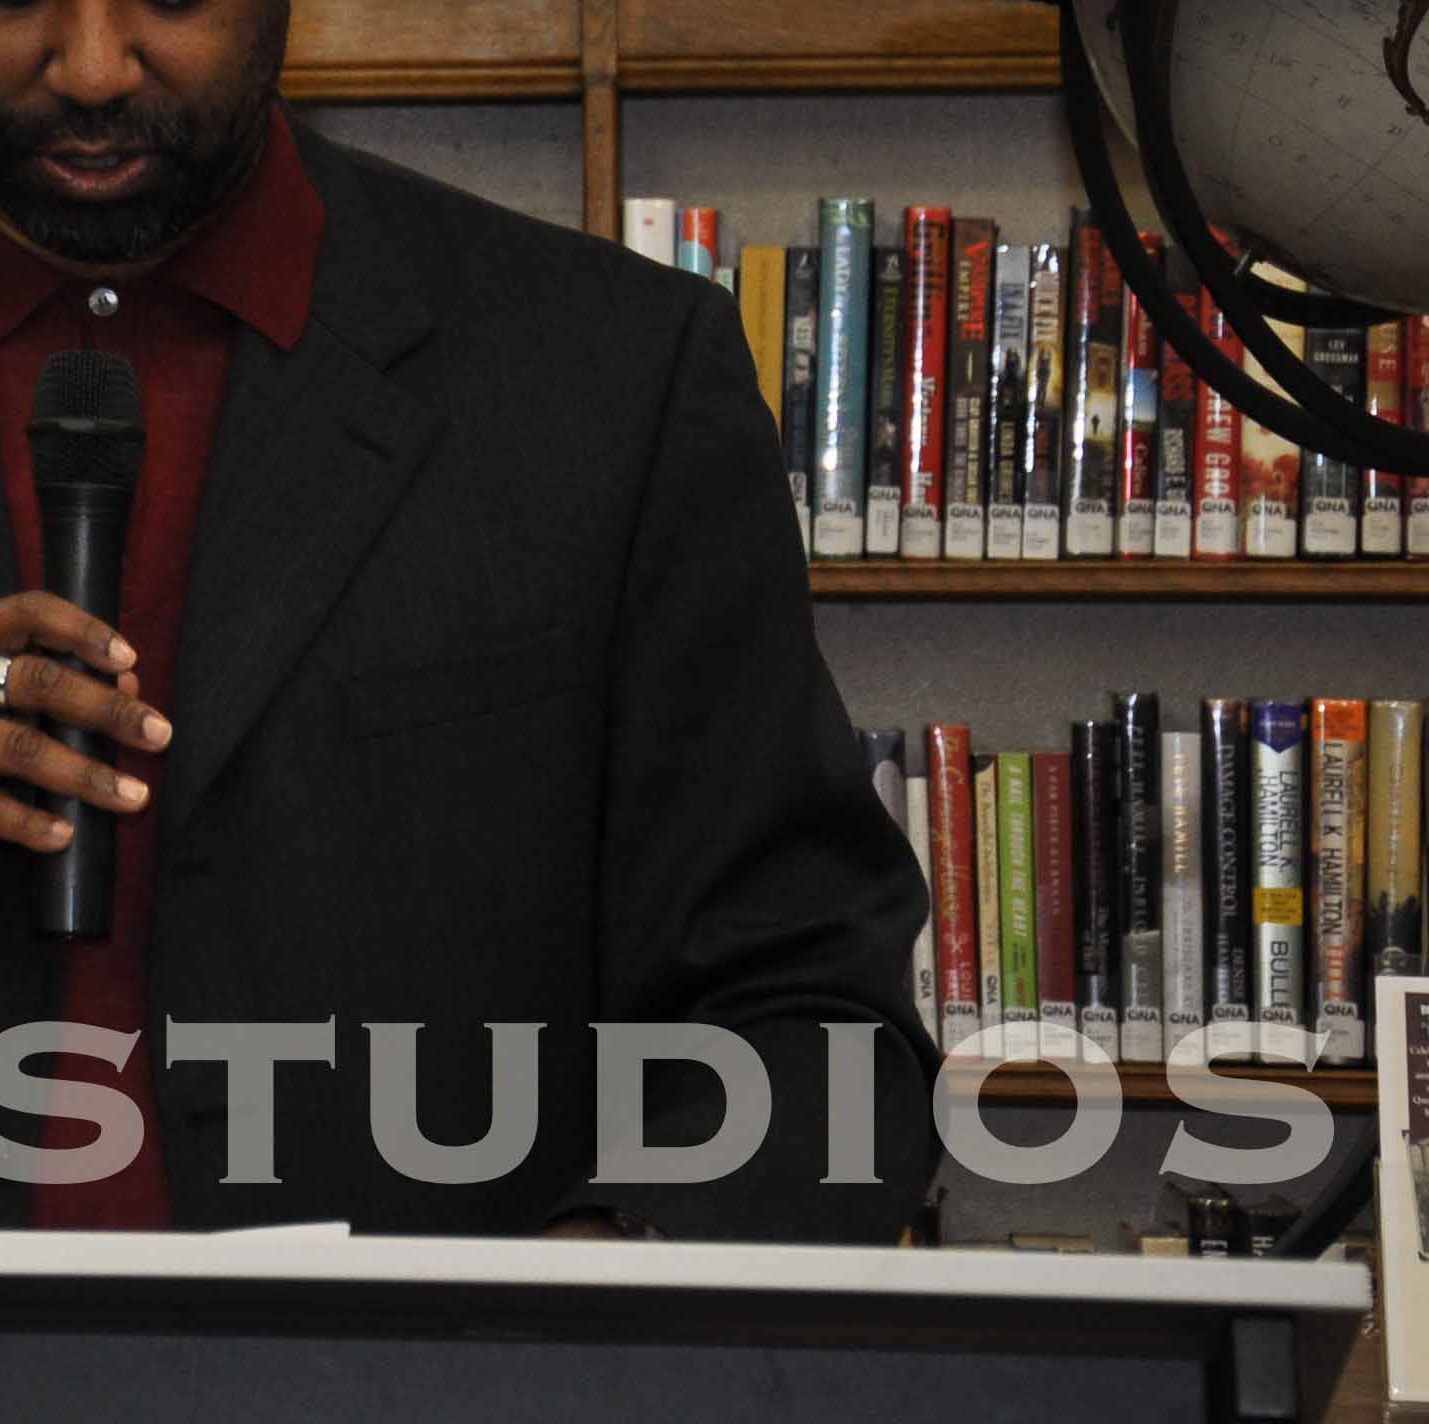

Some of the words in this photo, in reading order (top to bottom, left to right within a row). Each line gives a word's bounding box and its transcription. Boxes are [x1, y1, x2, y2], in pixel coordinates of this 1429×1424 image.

[957, 260, 971, 321] EMPIRE
[963, 240, 990, 341] VAMPIRE
[1313, 352, 1360, 364] GROSSMAN
[1328, 339, 1345, 351] LEV
[1205, 454, 1231, 496] GRO
[1220, 744, 1236, 824] DAMAGE
[1279, 771, 1299, 853] LAURELL
[1322, 741, 1344, 816] LAURELL
[1173, 805, 1189, 873] HAMILL
[1258, 775, 1279, 867] HAMILTON
[1220, 826, 1238, 920] CONTROL
[1322, 847, 1344, 936] HAMILTON
[959, 960, 973, 1001] LOUI
[1216, 933, 1230, 1002] HAMILTO
[1270, 940, 1289, 1007] BULLE
